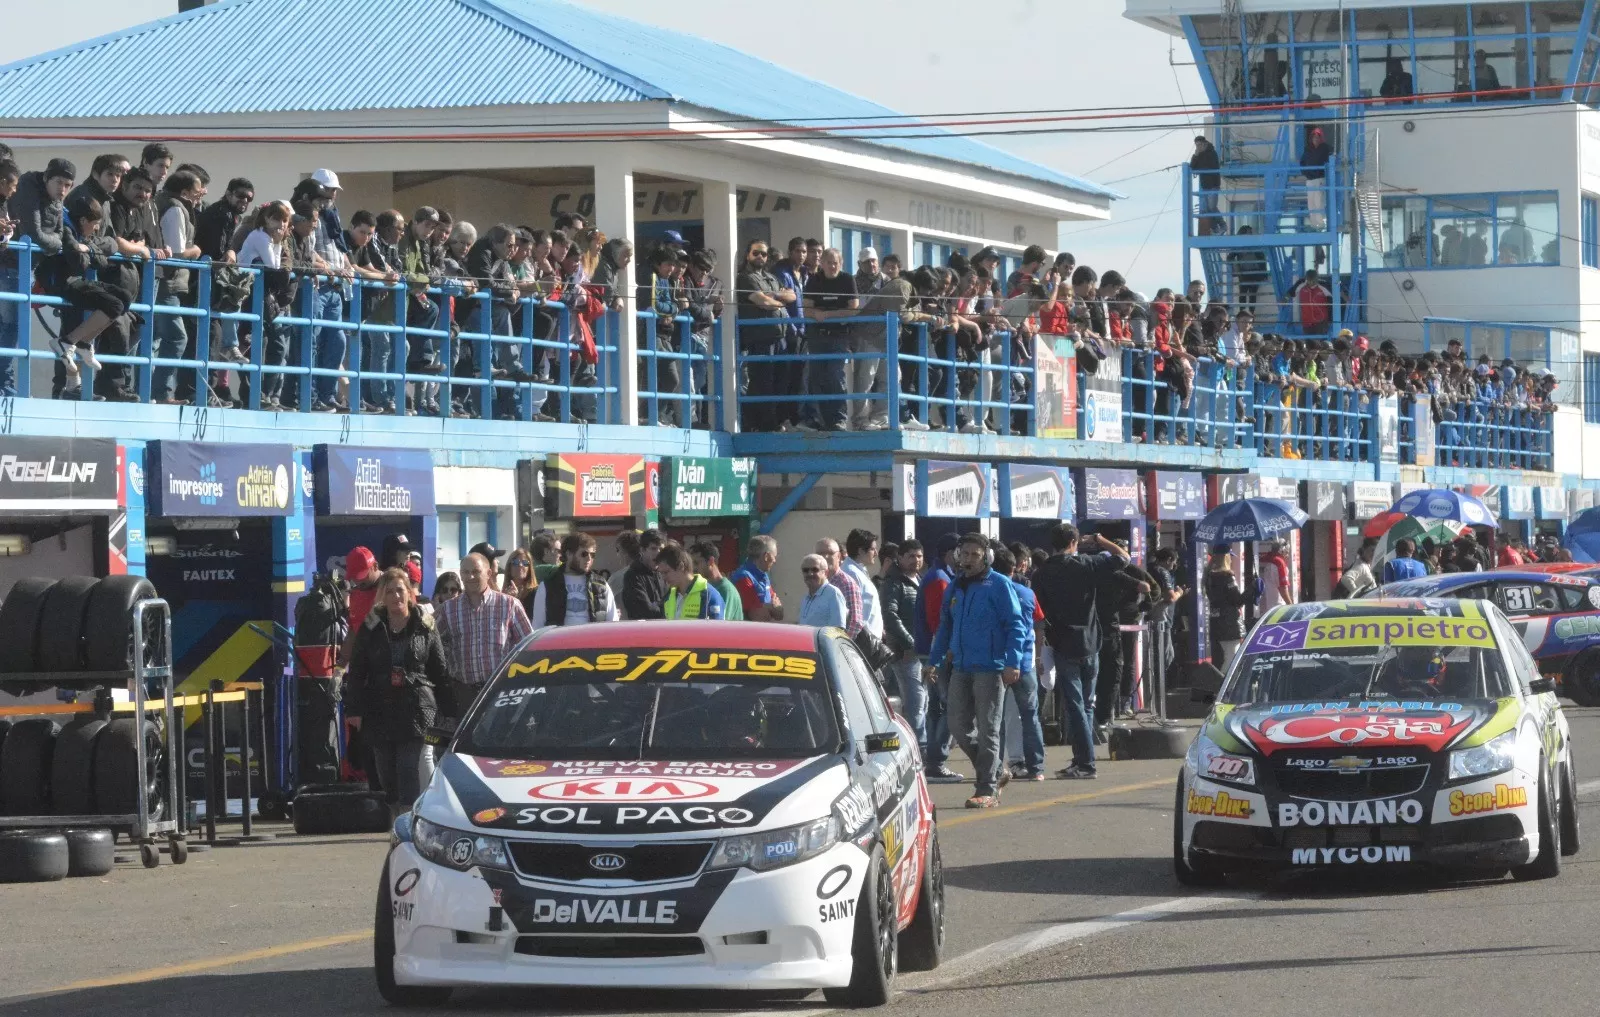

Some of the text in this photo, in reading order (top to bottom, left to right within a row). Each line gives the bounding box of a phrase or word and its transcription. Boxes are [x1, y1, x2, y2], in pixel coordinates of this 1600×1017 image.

[356, 458, 381, 484] Ariel
[677, 459, 705, 484] Iván
[169, 473, 223, 500] impresores
[1223, 523, 1255, 532] NUEVO
[1260, 515, 1288, 528] NUEVO
[1264, 521, 1293, 534] FOCUS
[1223, 530, 1256, 539] FOCUS
[183, 569, 235, 581] FAUTEX
[1507, 588, 1533, 610] 31
[1310, 617, 1490, 645] sampietro
[498, 687, 547, 699] LUNA
[495, 696, 524, 707] C3
[1267, 701, 1463, 715] JUAN PABLO
[1265, 715, 1445, 744] Costa
[552, 760, 777, 770] NUEVO BANCO
[1286, 756, 1417, 769] Lago Lago
[564, 767, 757, 777] DE LA RIOJA
[561, 780, 686, 797] KIA
[516, 807, 754, 825] SOL PAGO
[1278, 799, 1424, 827] BONANO
[454, 842, 471, 861] 35
[766, 843, 794, 855] POU
[1292, 846, 1411, 864] MYCOM
[594, 856, 620, 867] KIA
[533, 899, 678, 923] DelVALLE
[819, 899, 855, 923] SAINT
